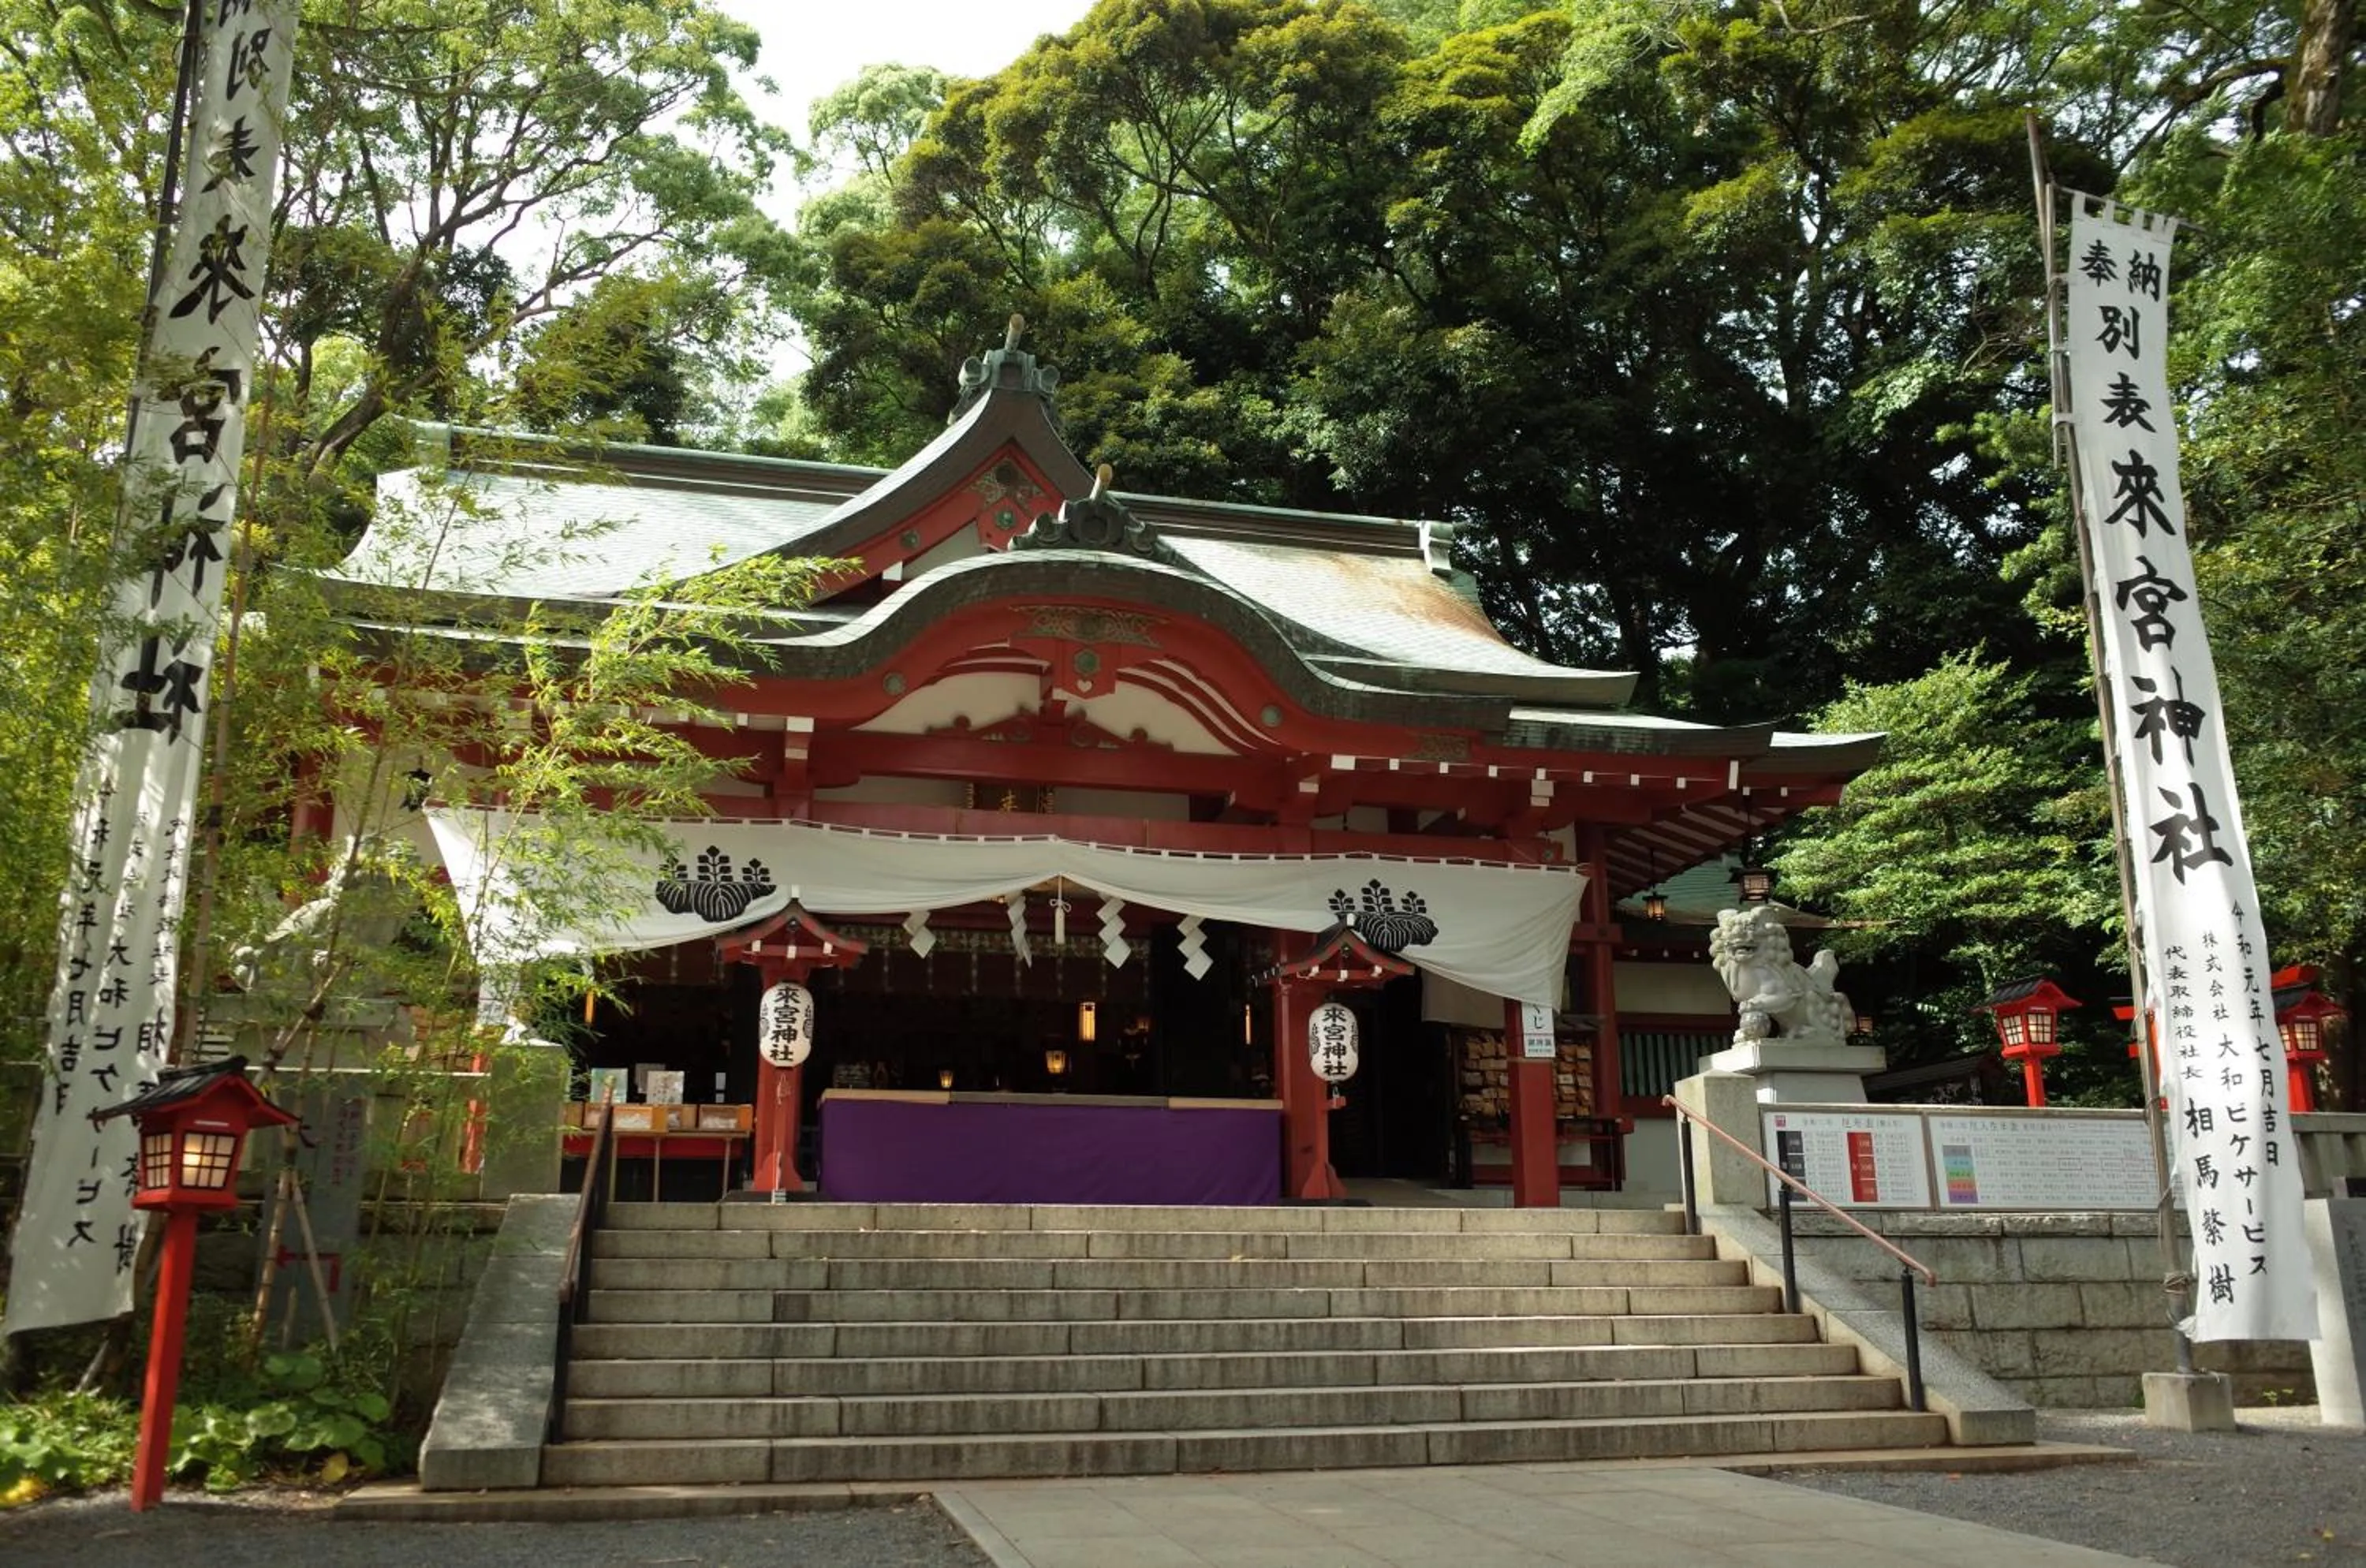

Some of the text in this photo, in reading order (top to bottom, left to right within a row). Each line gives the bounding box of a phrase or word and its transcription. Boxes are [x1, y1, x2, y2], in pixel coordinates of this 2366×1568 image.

[2080, 238, 2163, 303] 奉納
[2231, 898, 2280, 1168] 令和元年七月吉日
